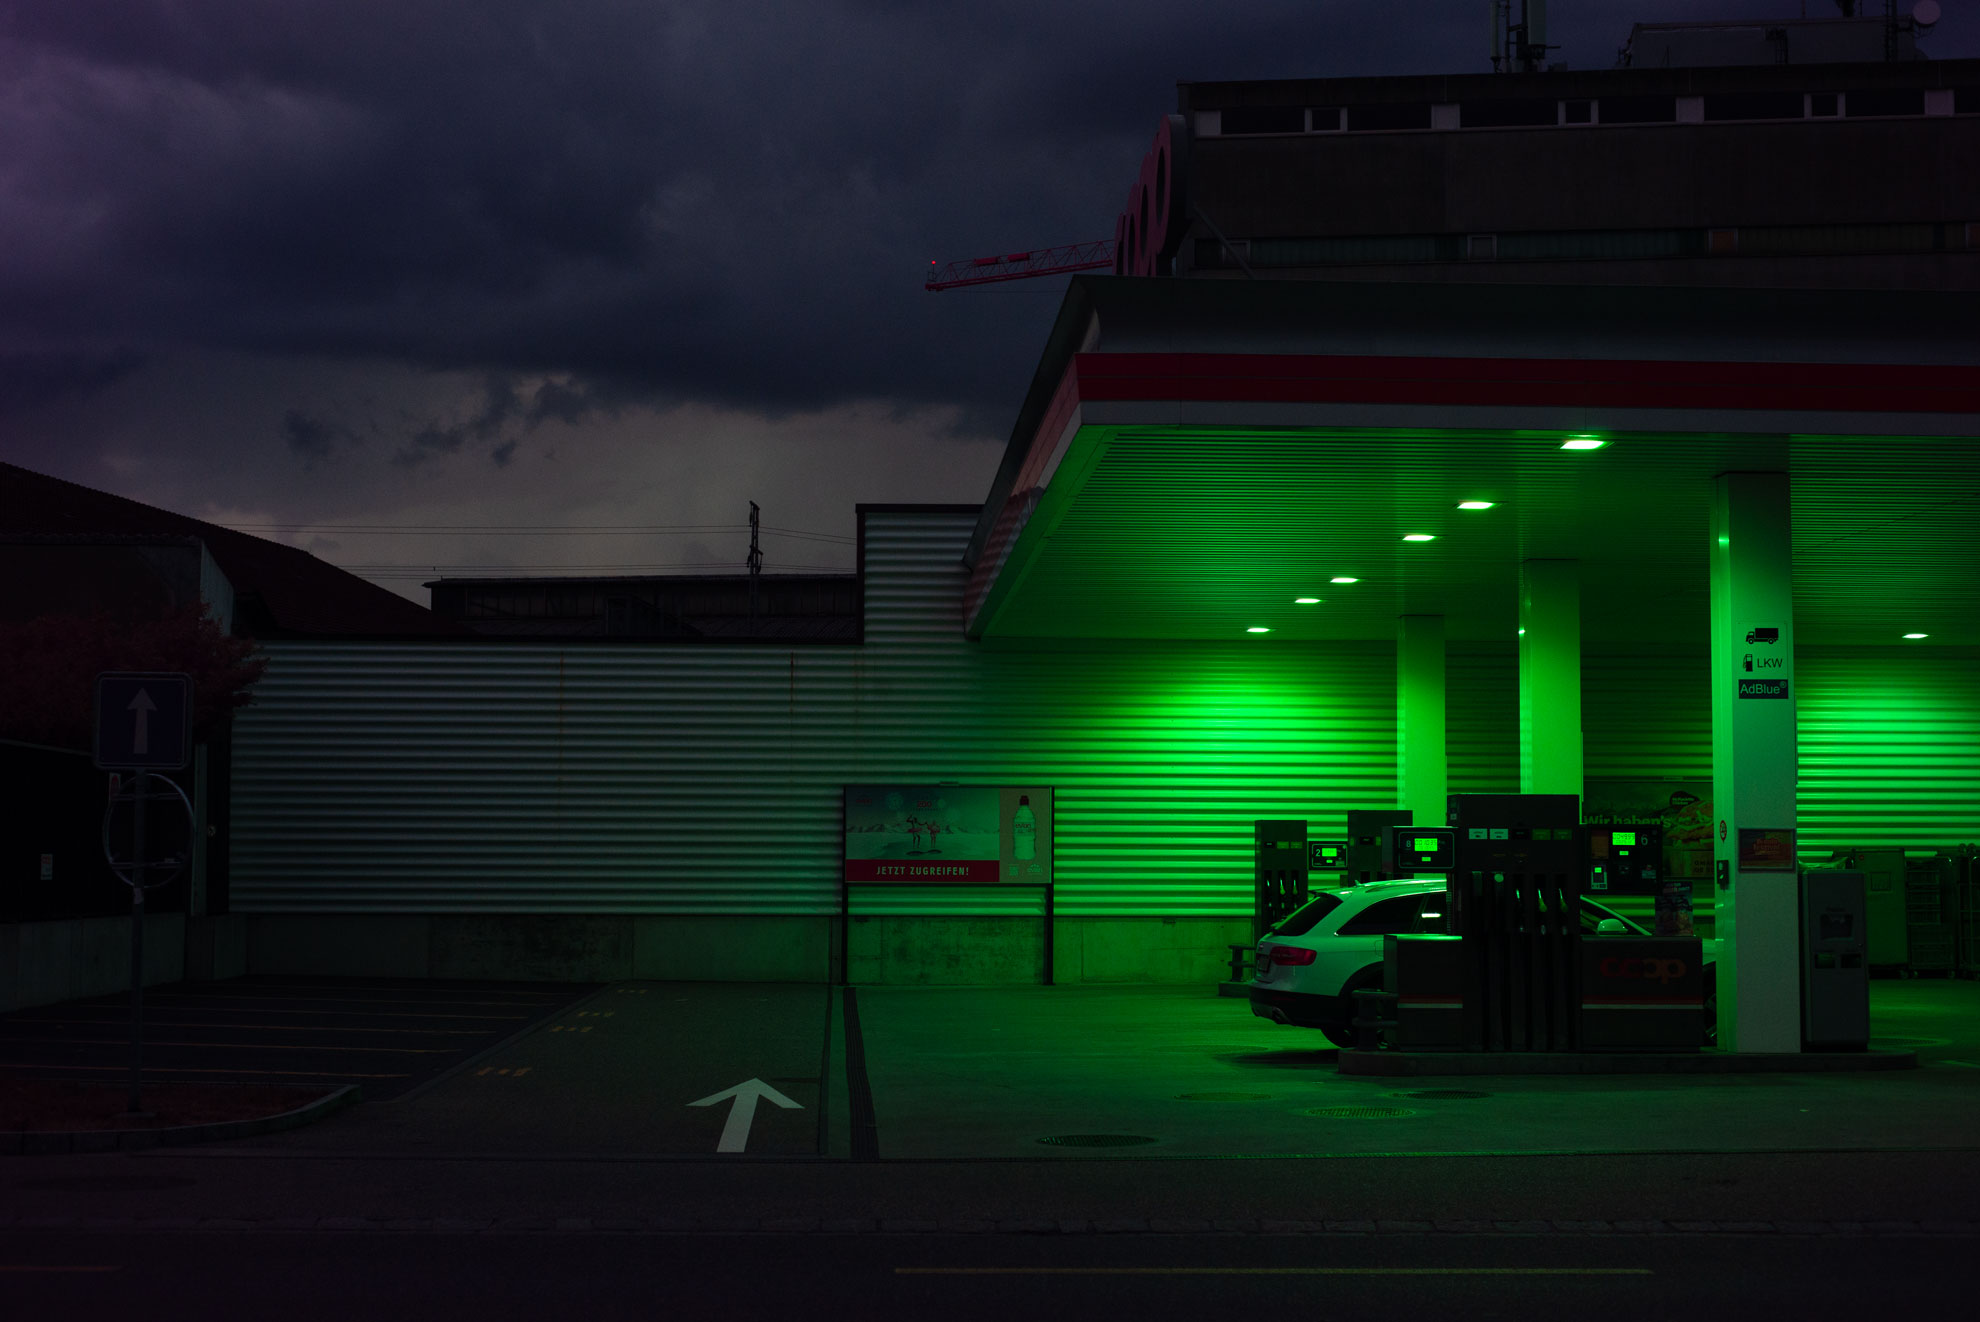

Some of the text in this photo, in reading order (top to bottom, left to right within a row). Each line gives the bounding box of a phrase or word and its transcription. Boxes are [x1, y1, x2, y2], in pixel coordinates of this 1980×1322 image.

[1757, 658, 1783, 668] LKW
[1584, 814, 1611, 825] Wir
[1640, 834, 1648, 846] 6
[1315, 848, 1321, 857] 2
[876, 866, 969, 876] JETZT ZUGREIFEN!
[1600, 956, 1687, 984] coop
